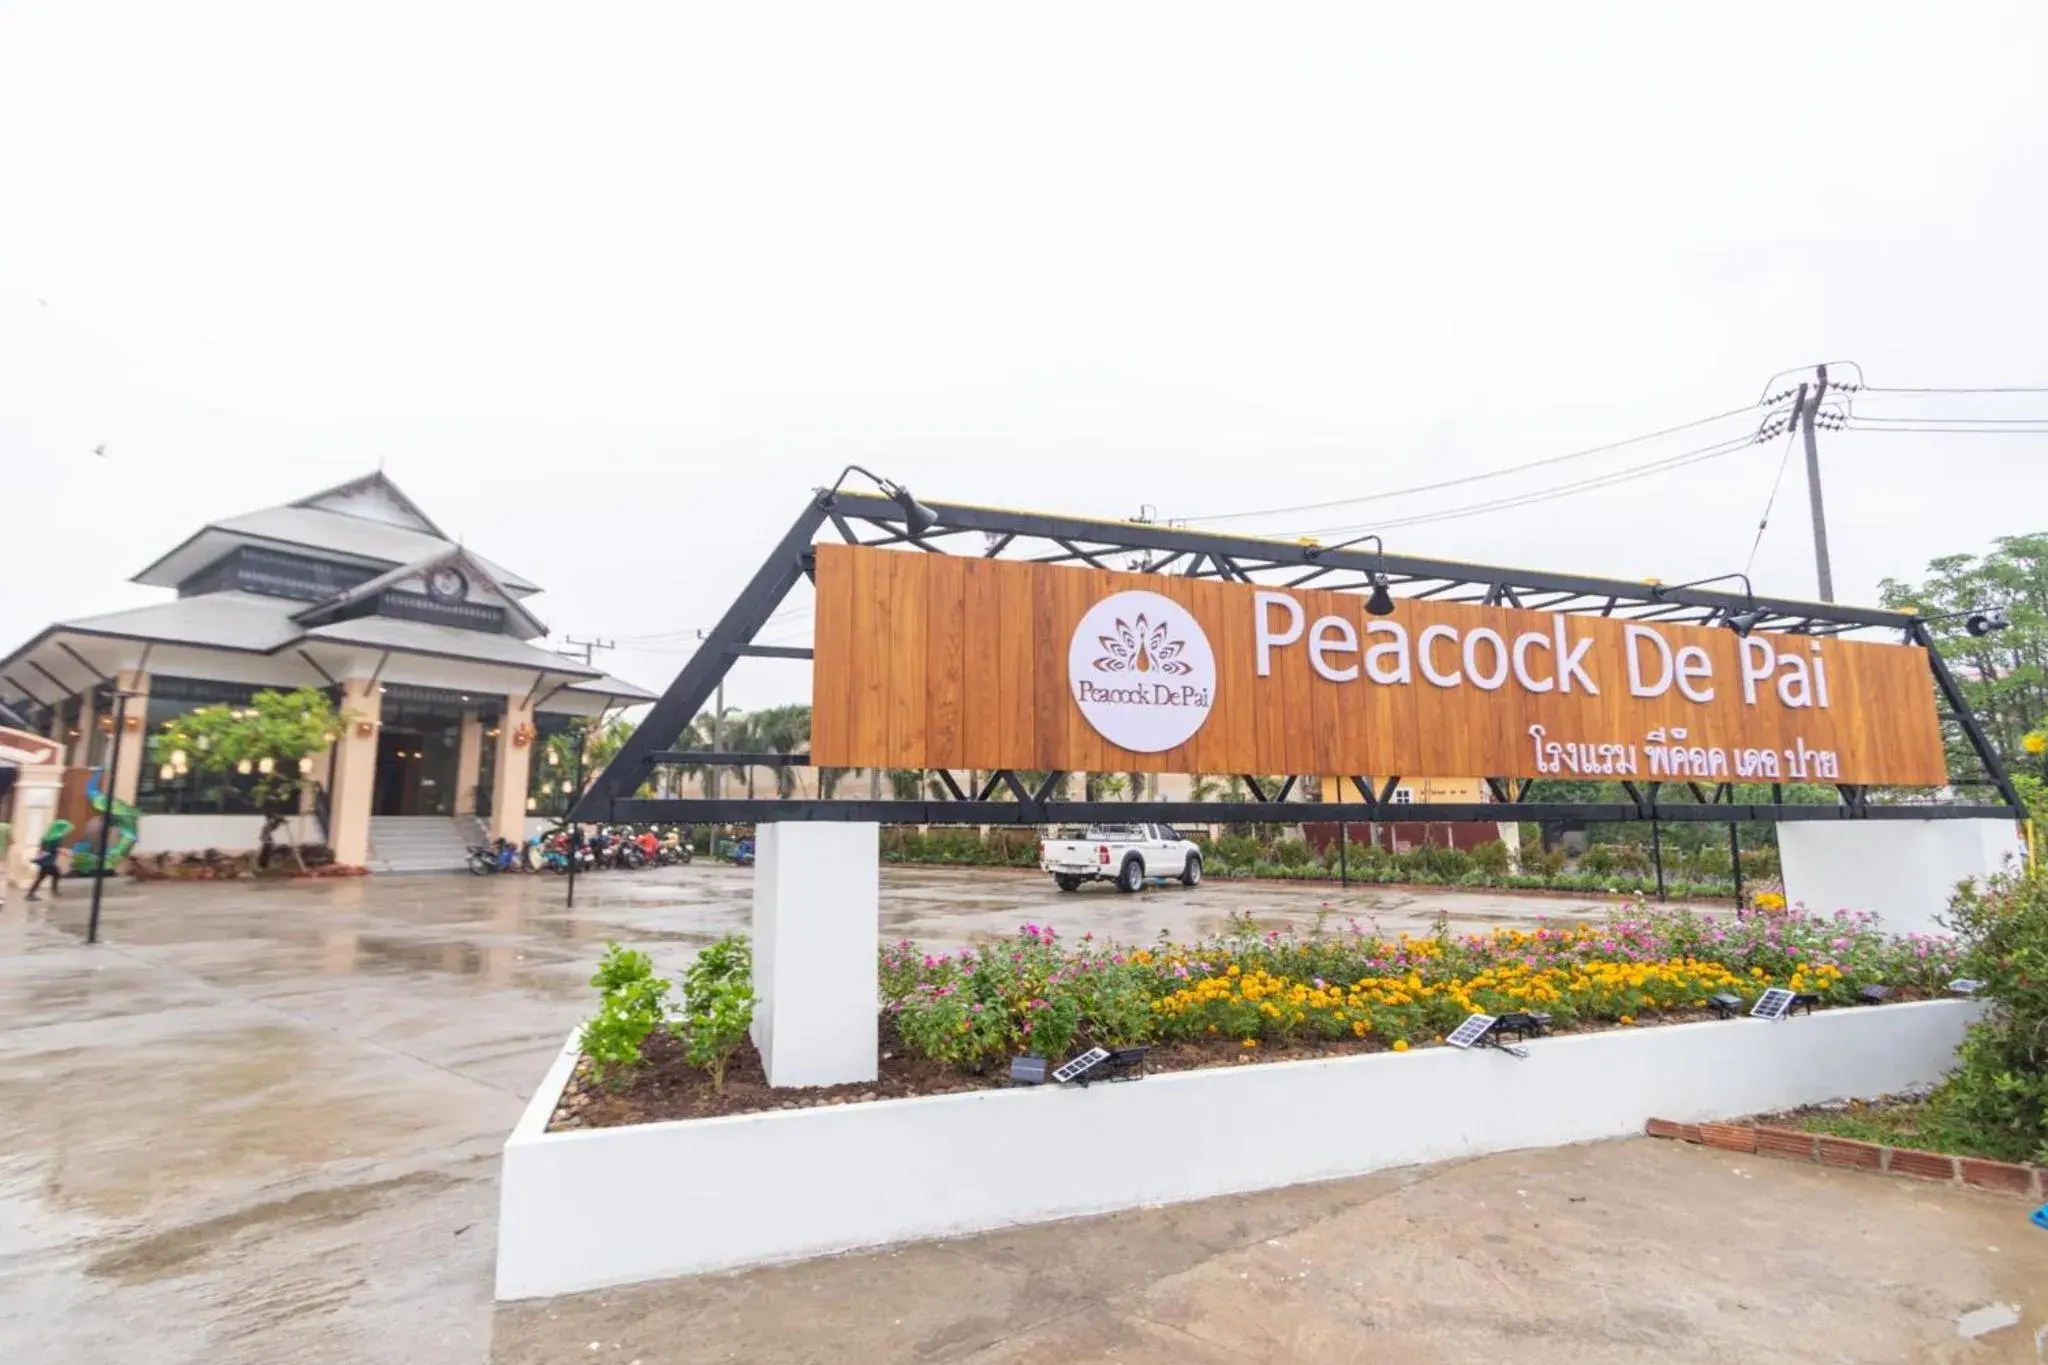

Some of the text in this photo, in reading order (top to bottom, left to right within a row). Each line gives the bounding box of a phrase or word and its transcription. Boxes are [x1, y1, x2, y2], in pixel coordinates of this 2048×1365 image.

[1253, 590, 1830, 709] Peacock De Pai
[1078, 680, 1151, 706] Peacock
[1528, 723, 1638, 775] โรงแรม
[1733, 747, 1781, 779] เดอ
[1784, 736, 1840, 779] ปาย
